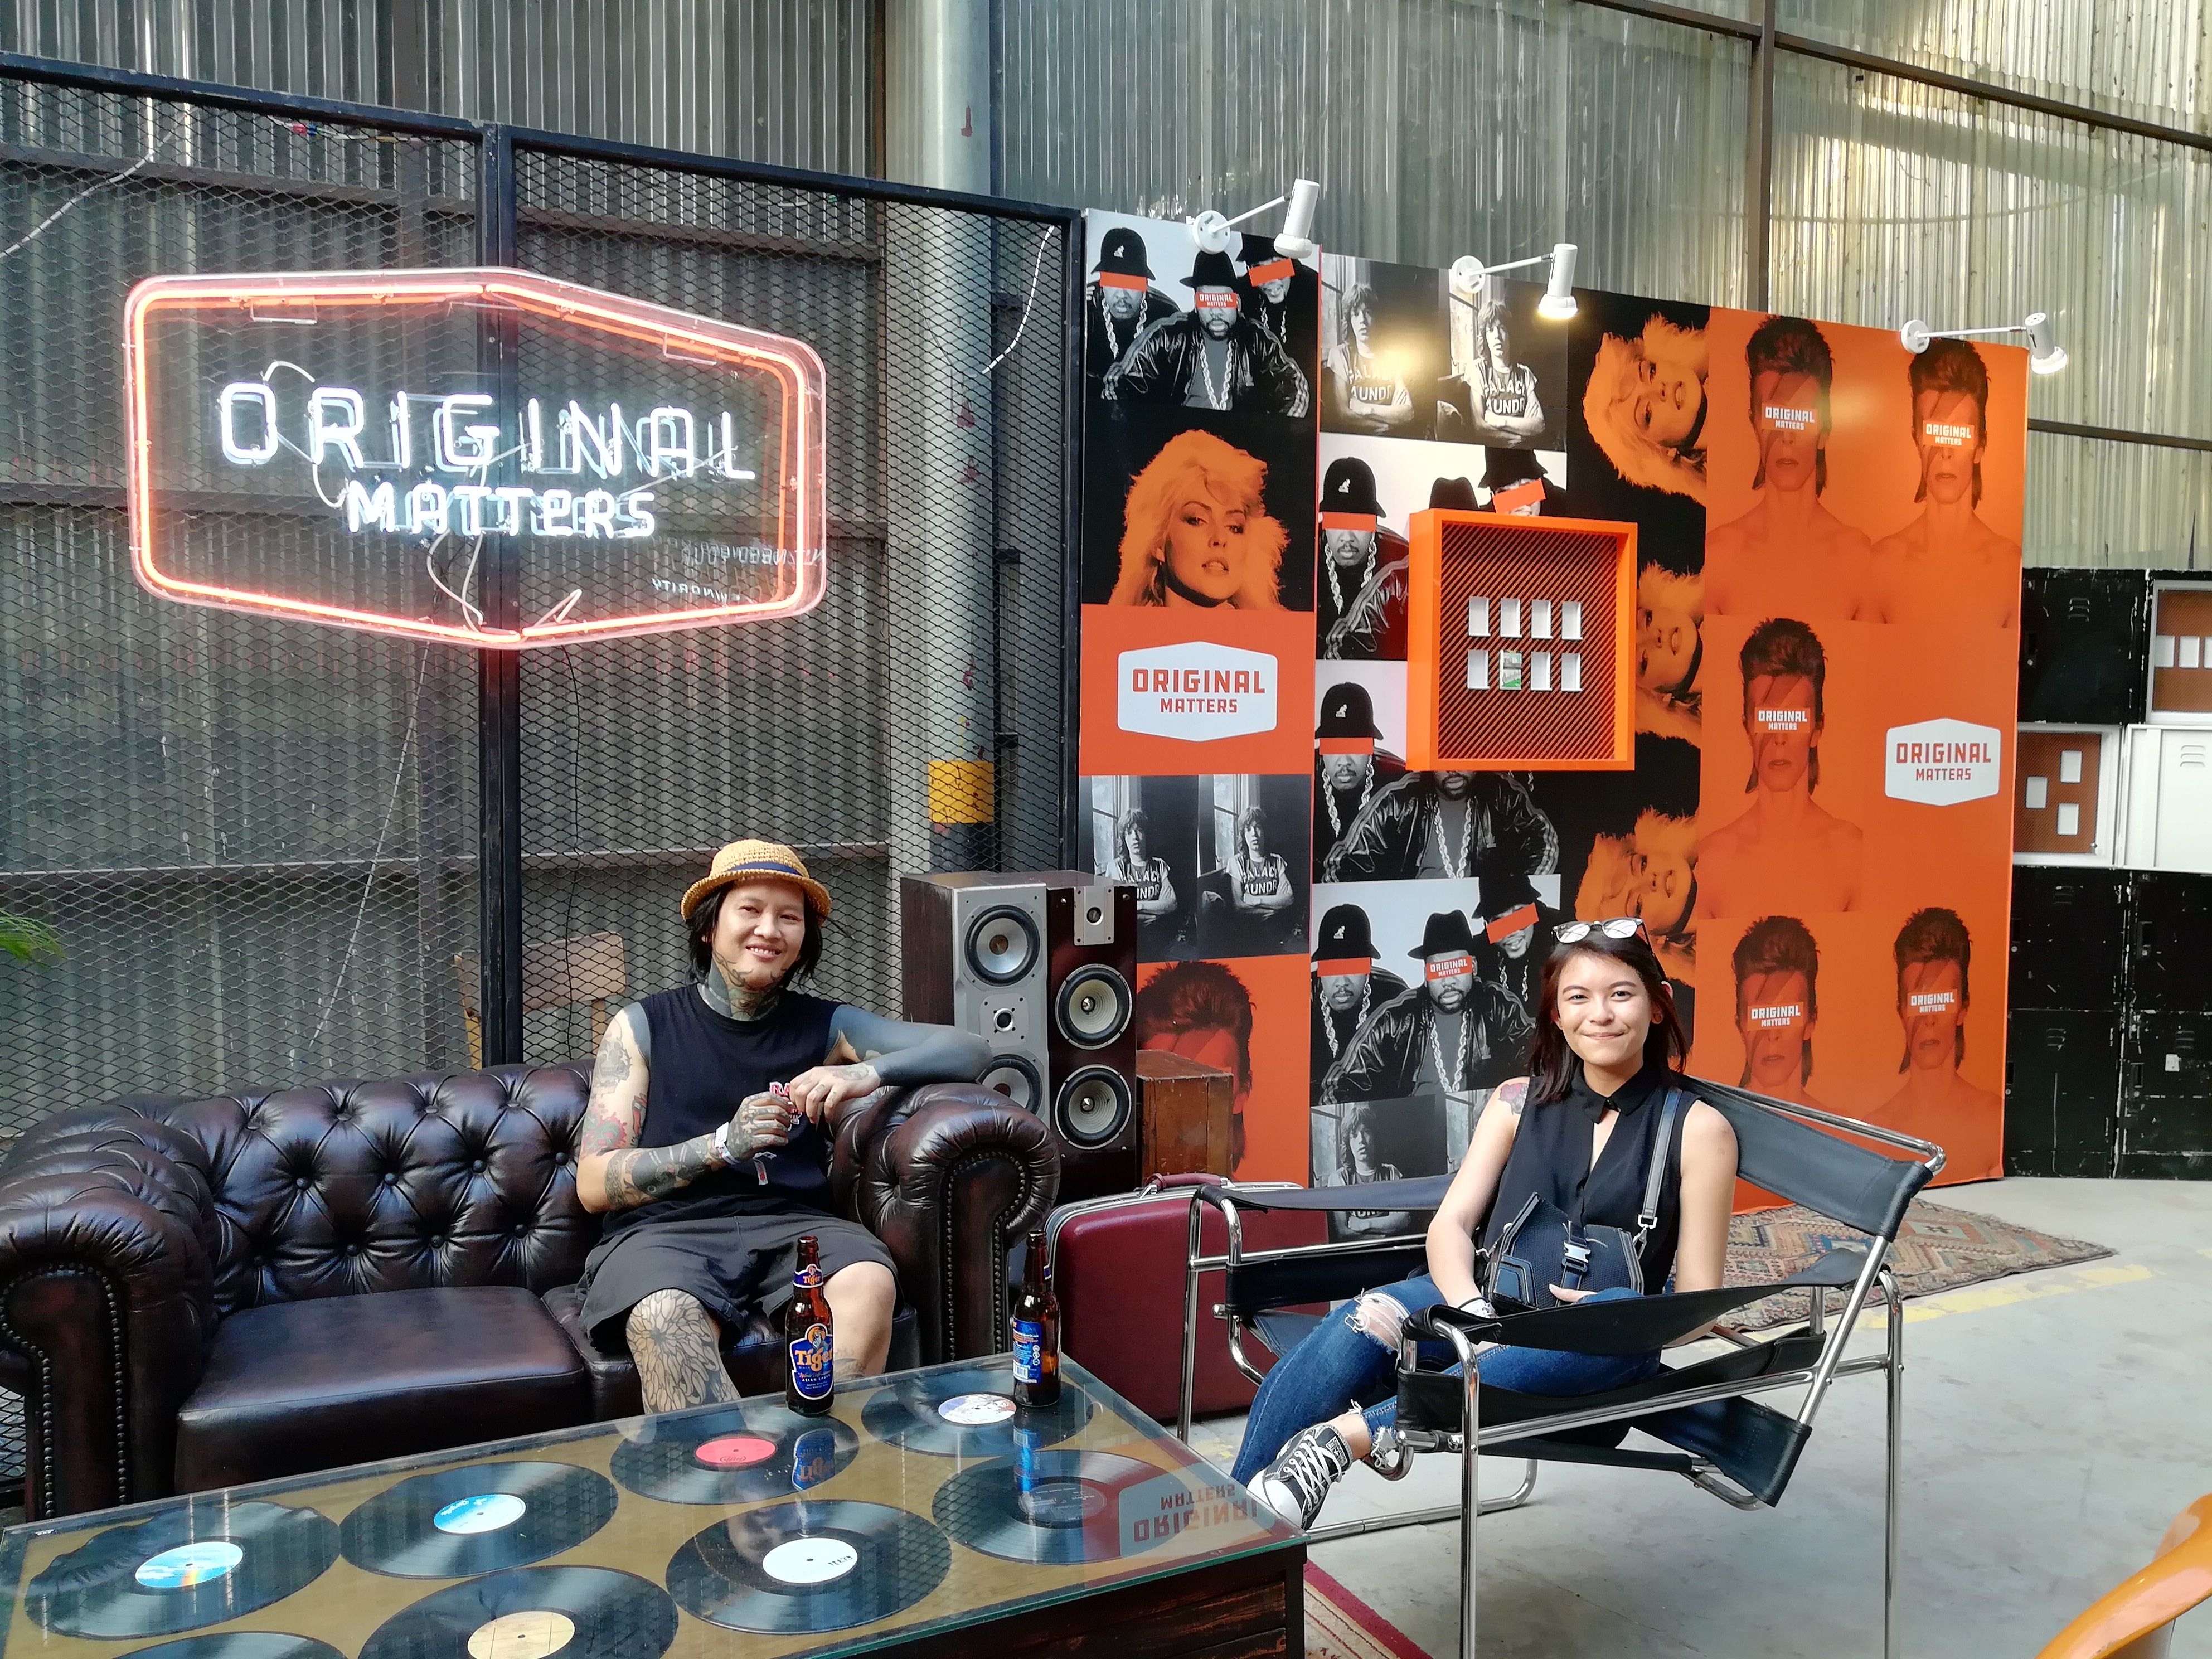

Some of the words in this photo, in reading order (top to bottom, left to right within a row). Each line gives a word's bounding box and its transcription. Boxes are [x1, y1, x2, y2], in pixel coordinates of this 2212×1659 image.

[1199, 293, 1233, 302] ORIGINAL
[1765, 406, 1815, 423] ORIGINAL
[220, 381, 756, 482] ORIGINAL
[1775, 420, 1804, 430] MATTERS
[1926, 424, 1972, 439] ORIGINAL
[1935, 436, 1962, 446] MATTERS
[347, 479, 656, 539] MATTERS
[1132, 668, 1266, 695] ORIGINAL
[1160, 698, 1238, 713] MATTERS
[1758, 710, 1807, 722] ORIGINAL
[1768, 722, 1797, 731] MATTERS
[1896, 743, 1992, 764] ORIGINAL
[1915, 768, 1972, 782] MATTERS
[1430, 958, 1468, 973] ORIGINAL
[1438, 968, 1461, 977] MATTERS
[1911, 992, 1955, 1006] ORIGINAL
[1751, 1005, 1801, 1020] ORIGINAL
[1919, 1004, 1946, 1013] MATTERS
[1761, 1017, 1791, 1027] MATTERS
[803, 1275, 821, 1286] Tiger
[794, 1347, 833, 1372] Tiger
